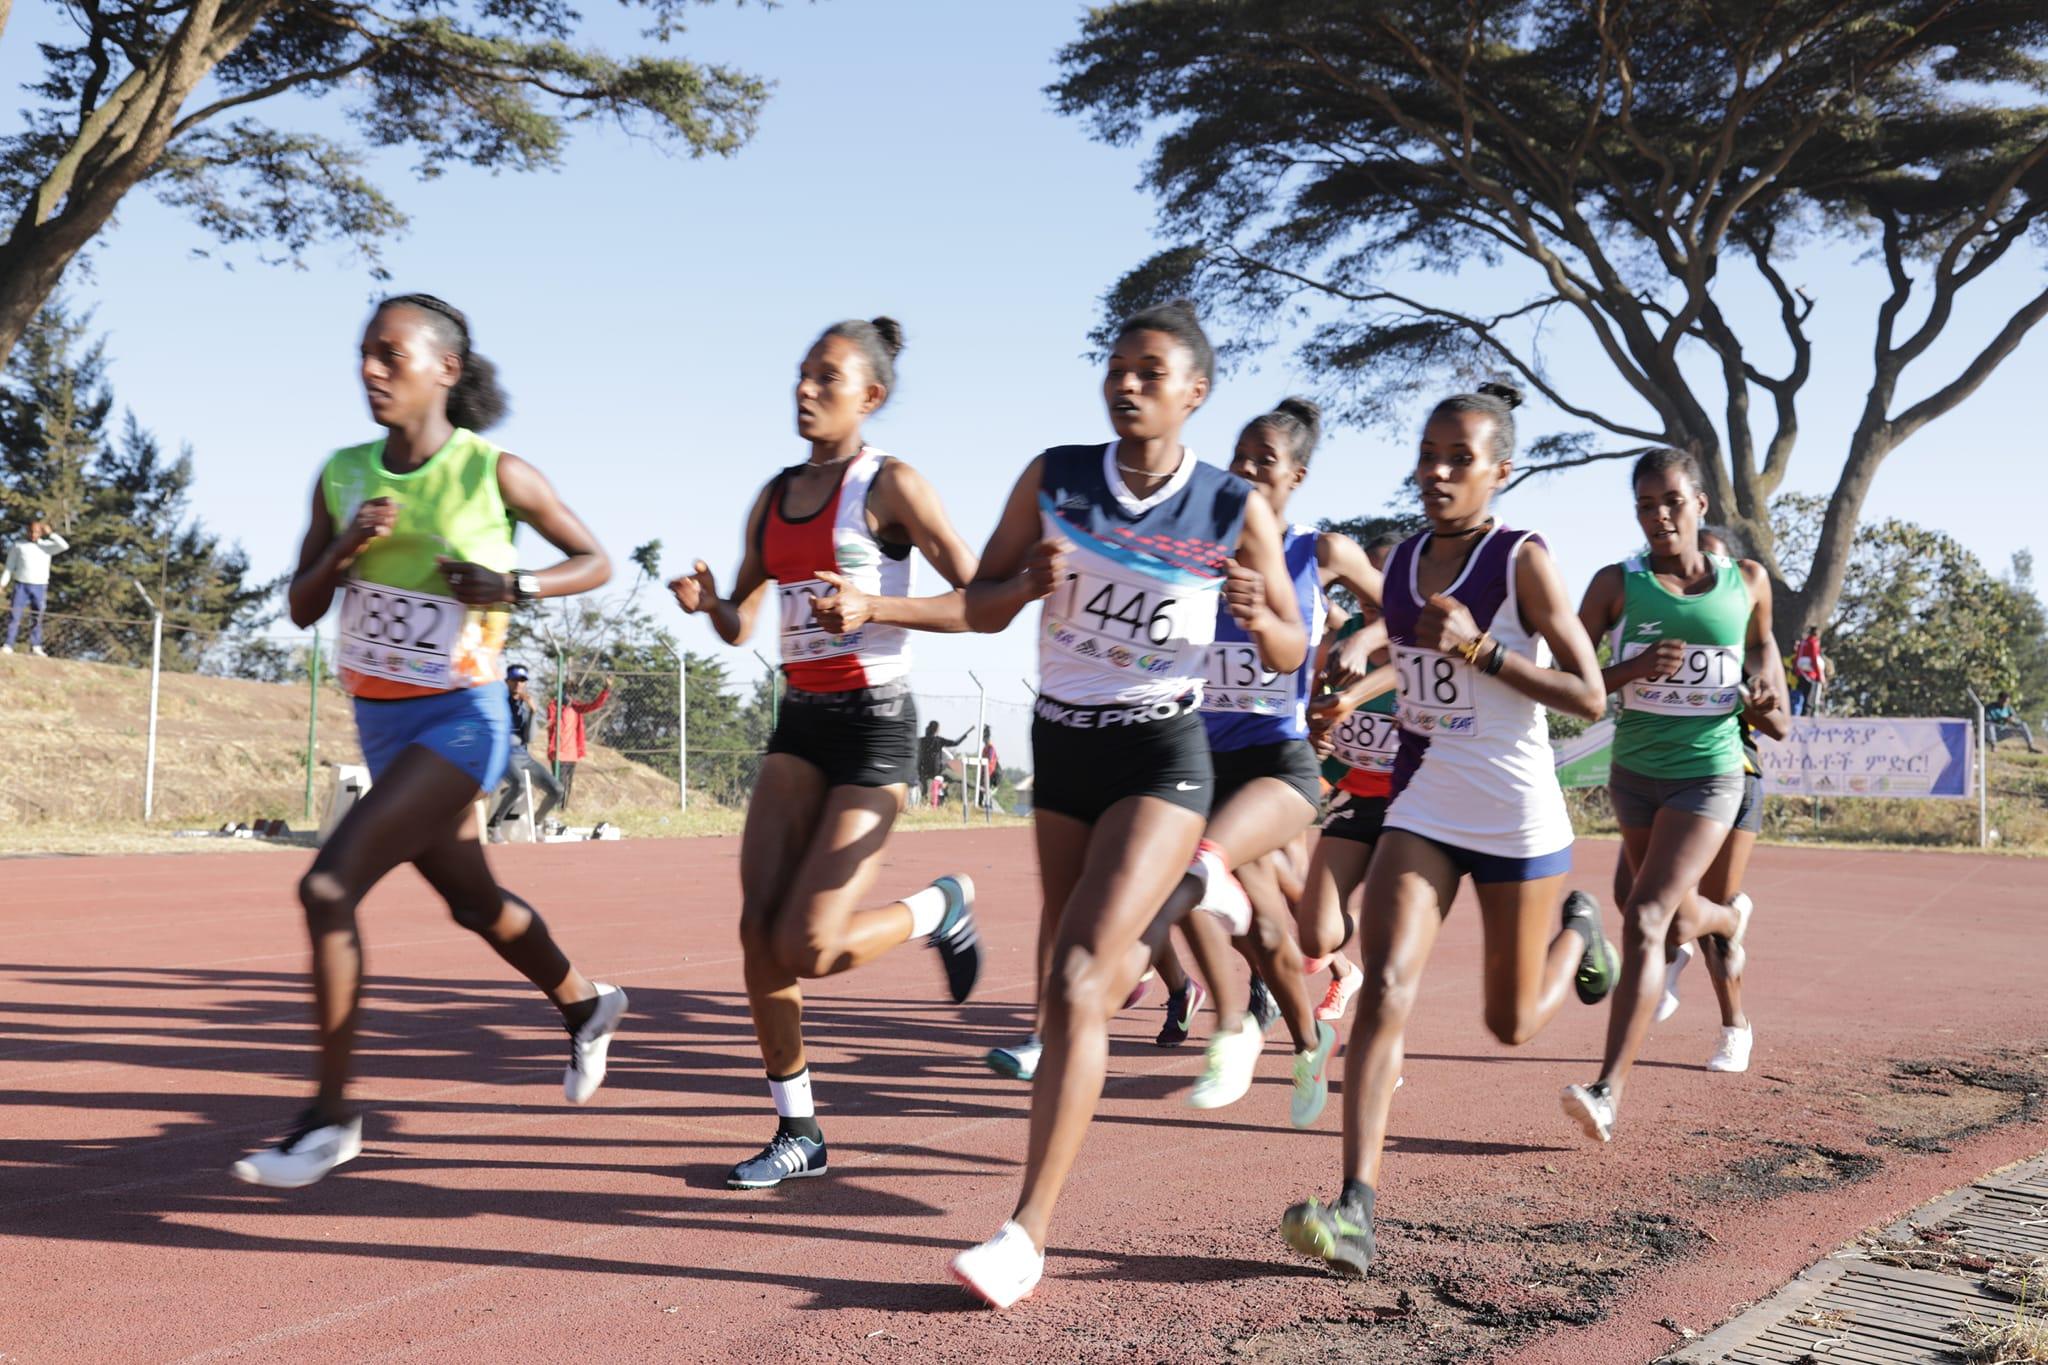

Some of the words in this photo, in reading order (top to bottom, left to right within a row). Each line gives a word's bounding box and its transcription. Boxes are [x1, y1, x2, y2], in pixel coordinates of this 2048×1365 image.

[1066, 572, 1177, 646] 1446
[1203, 648, 1281, 687] 139
[1646, 650, 1724, 685] 291
[1097, 701, 1180, 729] PRO
